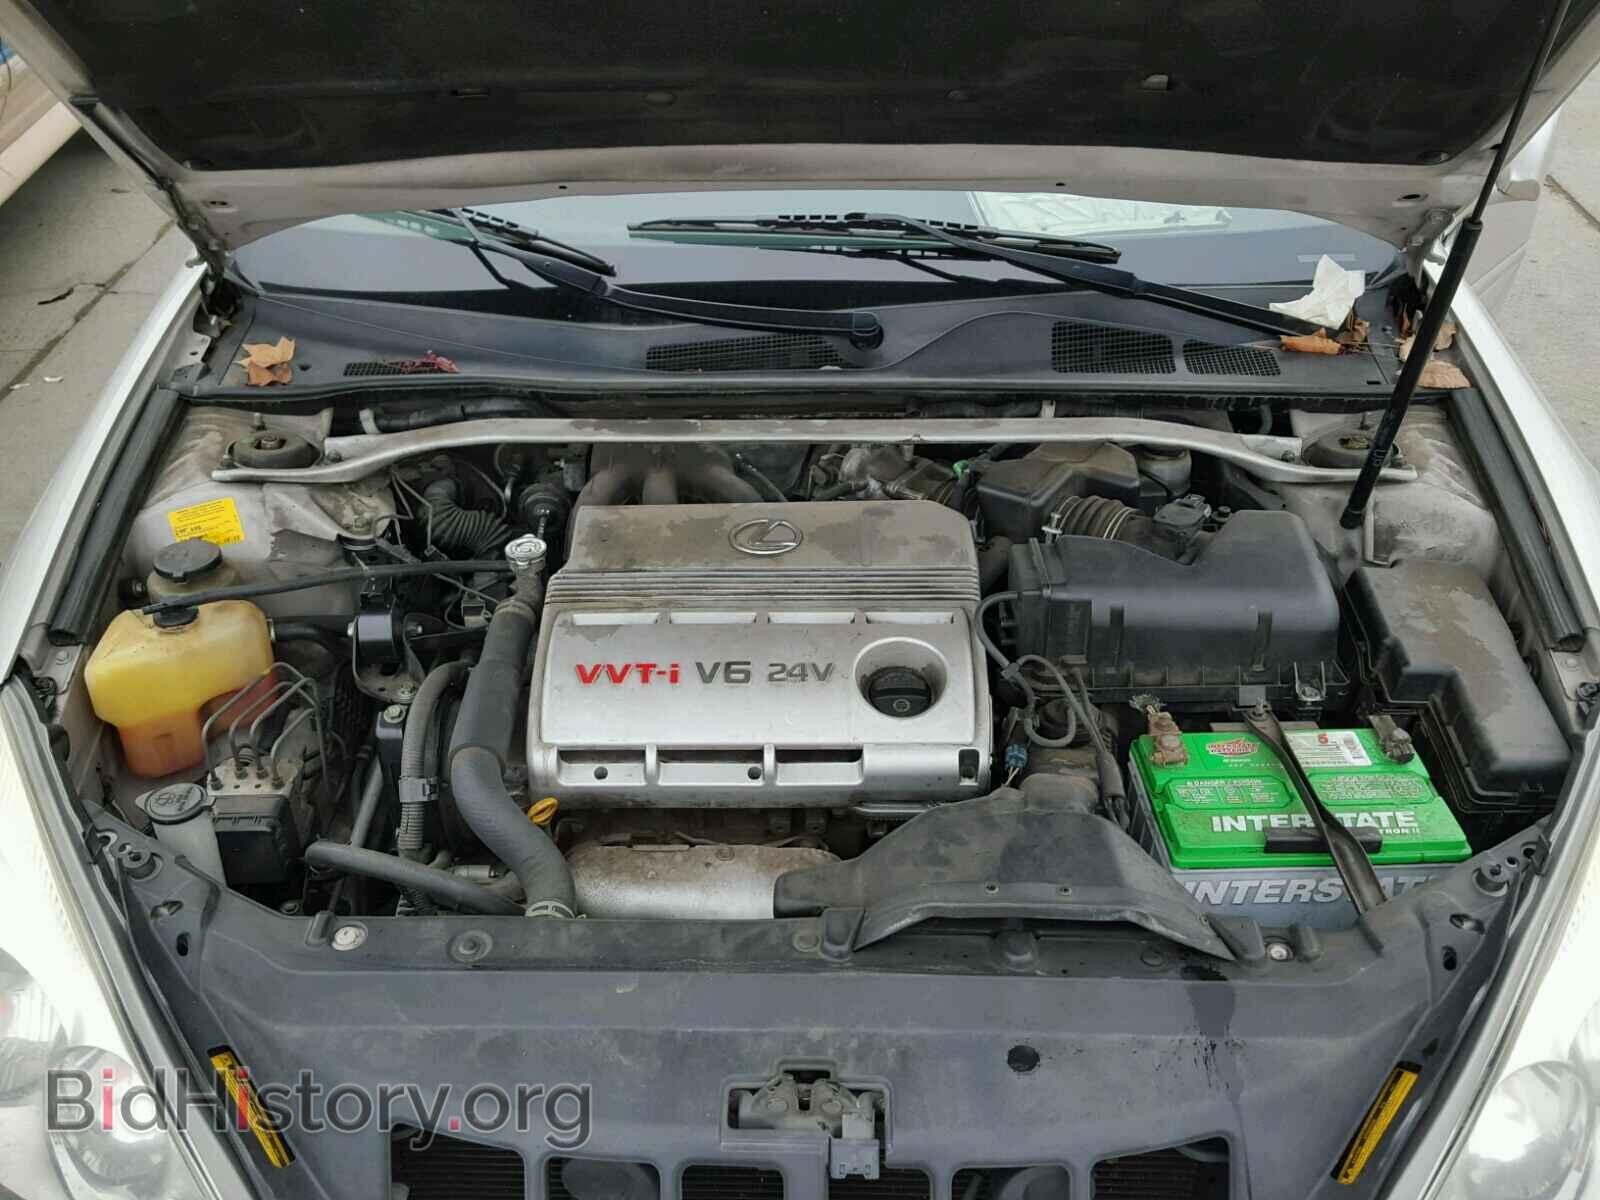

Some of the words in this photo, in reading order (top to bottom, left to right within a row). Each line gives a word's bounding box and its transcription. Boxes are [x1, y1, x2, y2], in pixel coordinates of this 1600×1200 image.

[575, 663, 680, 684] VVT-i
[695, 661, 752, 684] V6
[767, 662, 834, 682] 24V
[1211, 812, 1418, 832] INTERTATE
